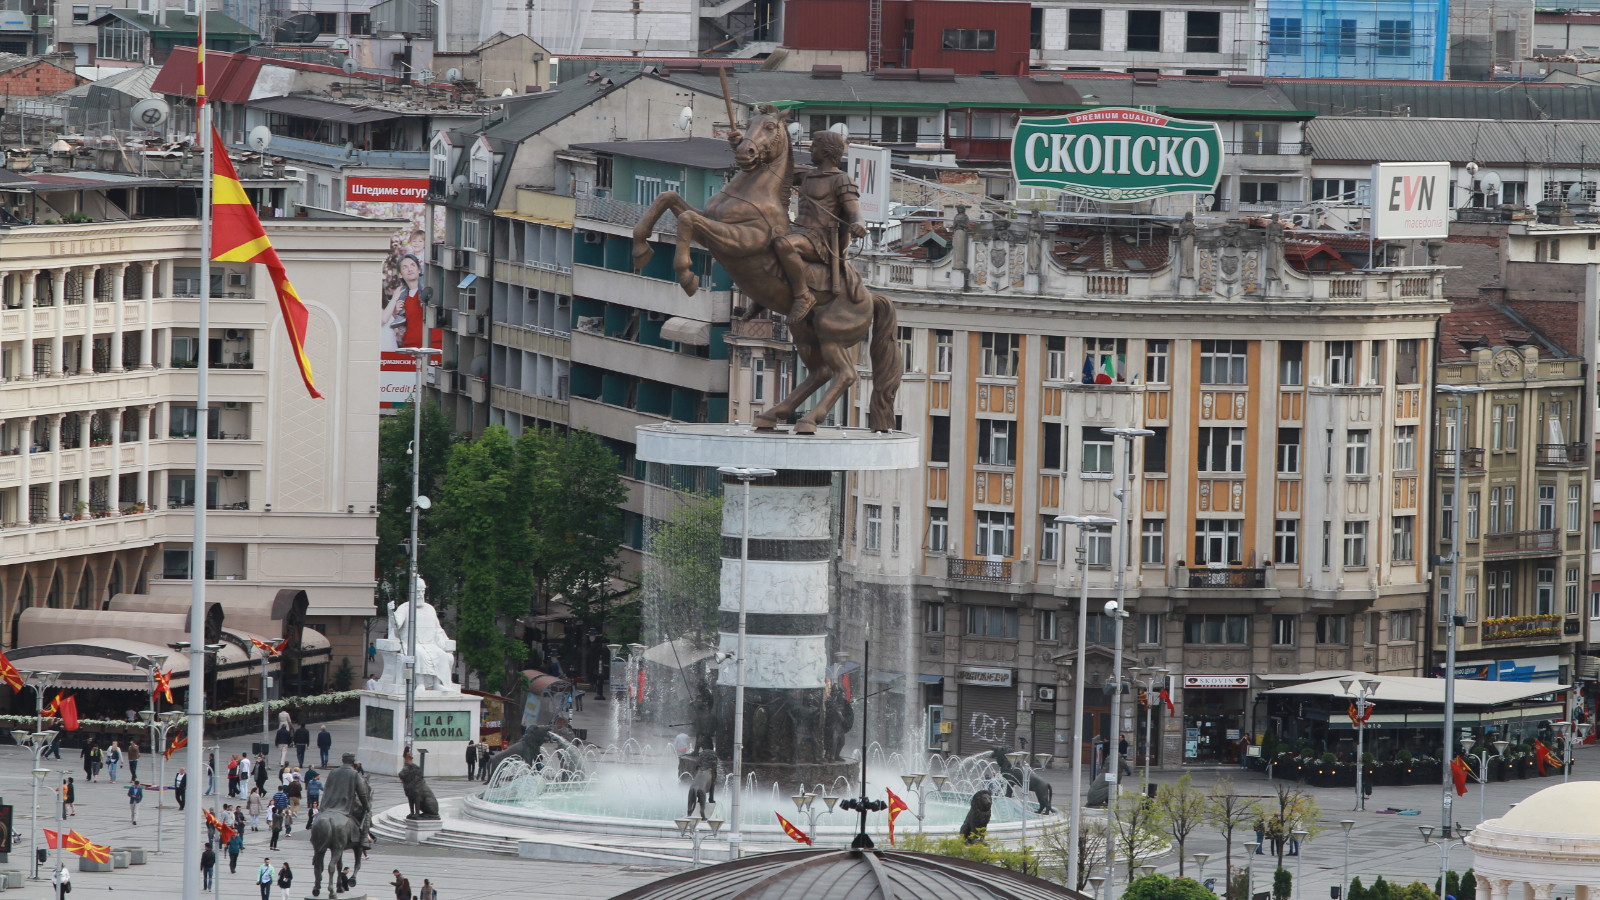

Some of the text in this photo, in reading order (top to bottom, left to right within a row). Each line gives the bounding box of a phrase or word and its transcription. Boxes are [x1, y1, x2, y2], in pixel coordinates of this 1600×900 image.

[1076, 112, 1160, 124] PREMIUM QUALITY
[1024, 132, 1210, 177] СКОПСКО
[352, 184, 399, 197] Штедиме
[1389, 176, 1436, 211] EVN
[1405, 216, 1443, 229] macedonia
[424, 715, 454, 726] ЦАР
